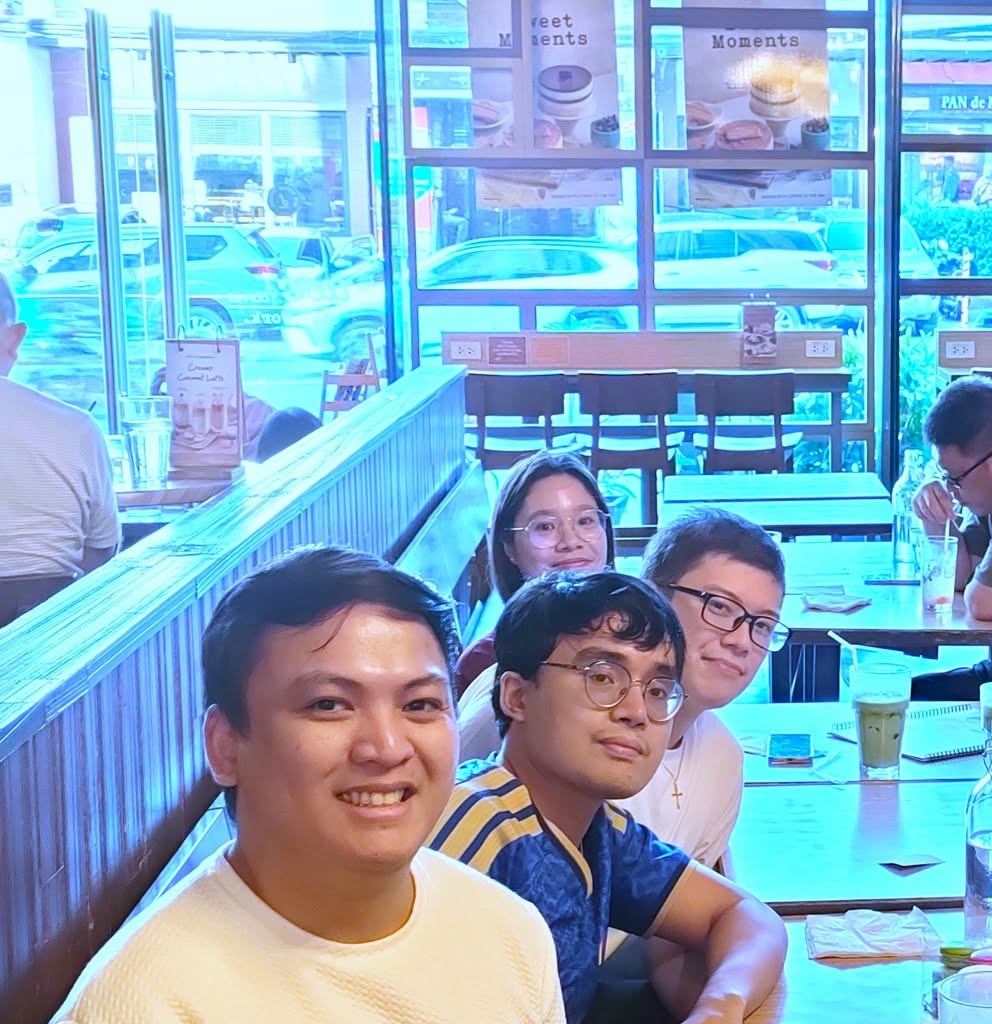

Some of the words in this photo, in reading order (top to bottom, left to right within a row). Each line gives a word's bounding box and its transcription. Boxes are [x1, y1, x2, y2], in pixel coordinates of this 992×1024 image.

[711, 33, 800, 49] Moments
[941, 96, 968, 109] PAN
[970, 95, 986, 109] de
